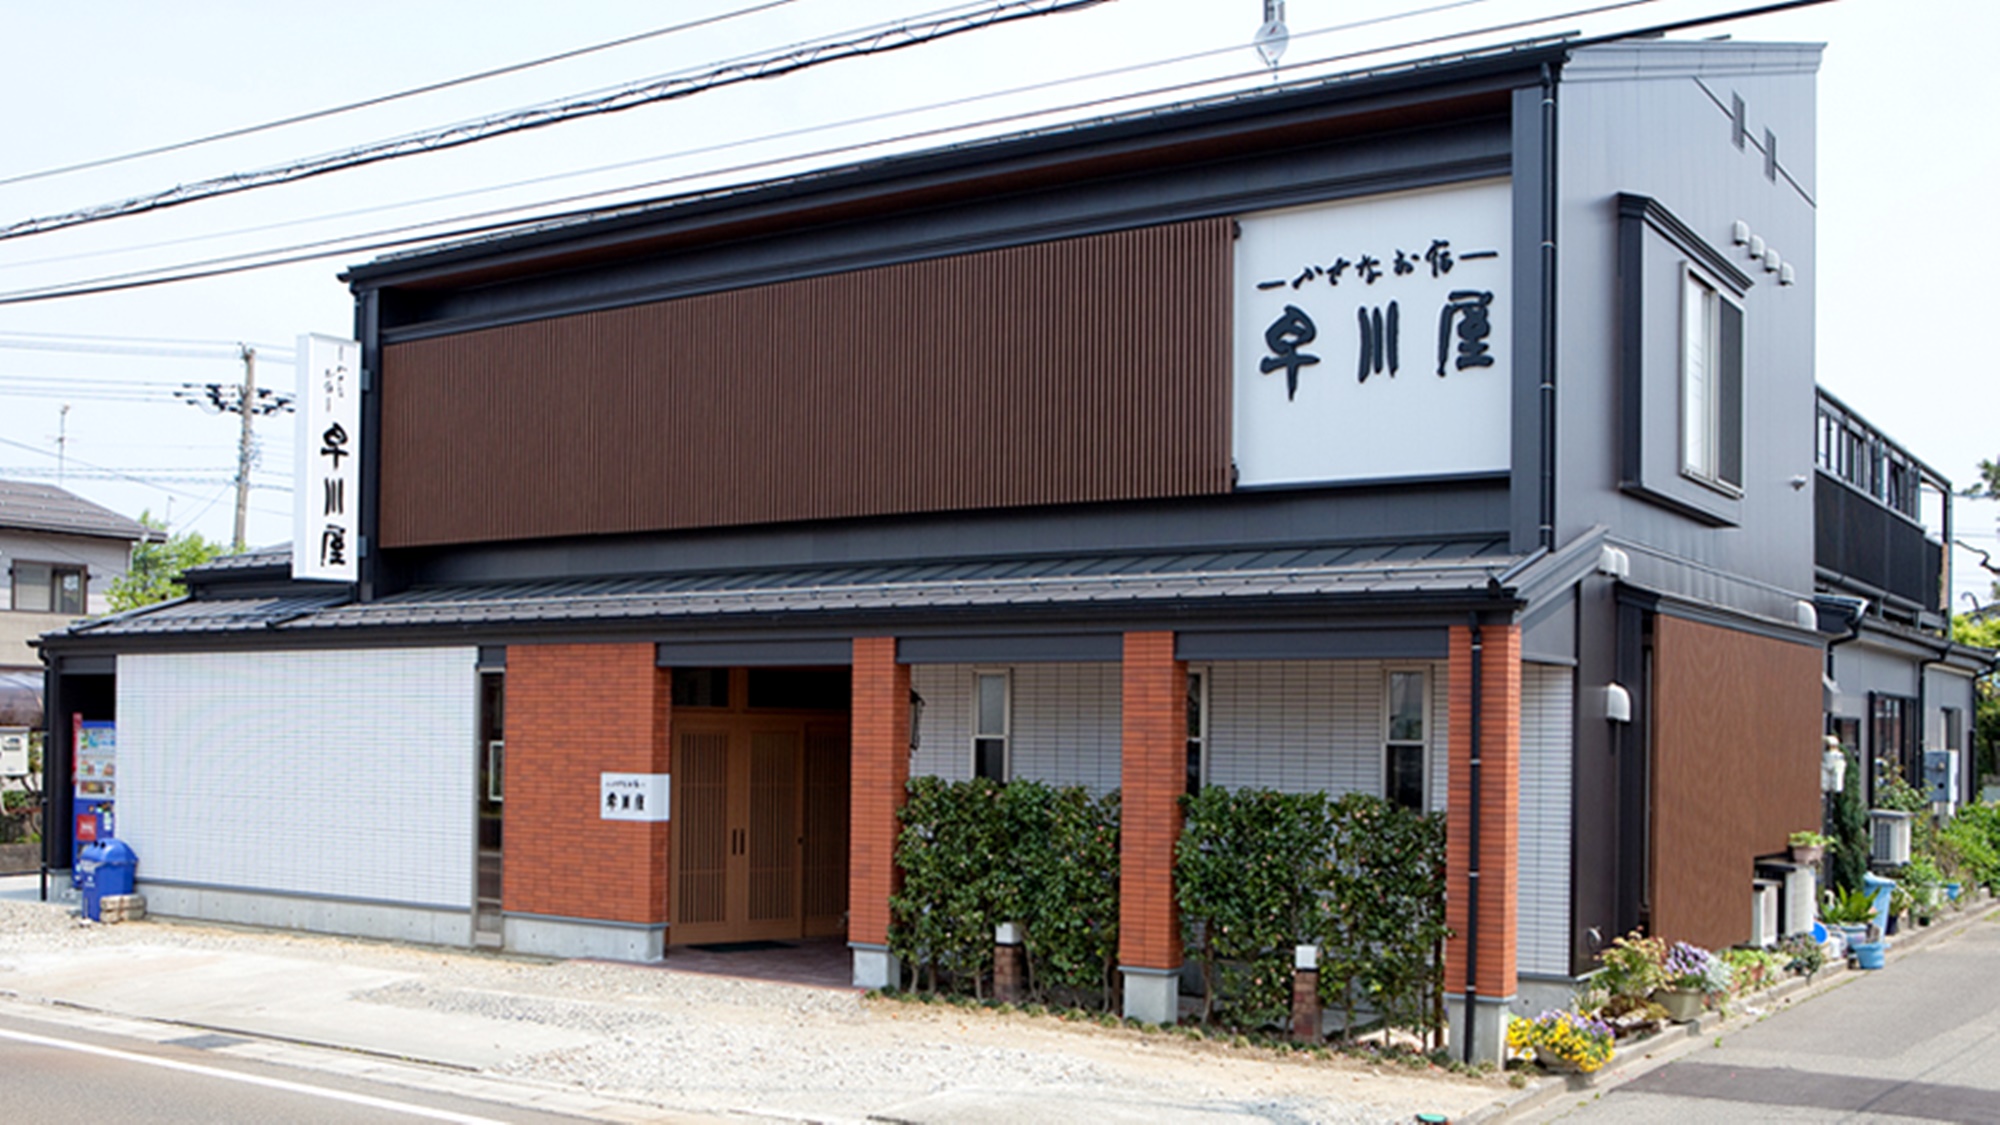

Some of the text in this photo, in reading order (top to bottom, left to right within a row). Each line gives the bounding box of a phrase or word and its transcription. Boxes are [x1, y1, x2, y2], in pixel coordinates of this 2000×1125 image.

[1259, 290, 1495, 402] 早川屋
[320, 422, 349, 567] 早川屋
